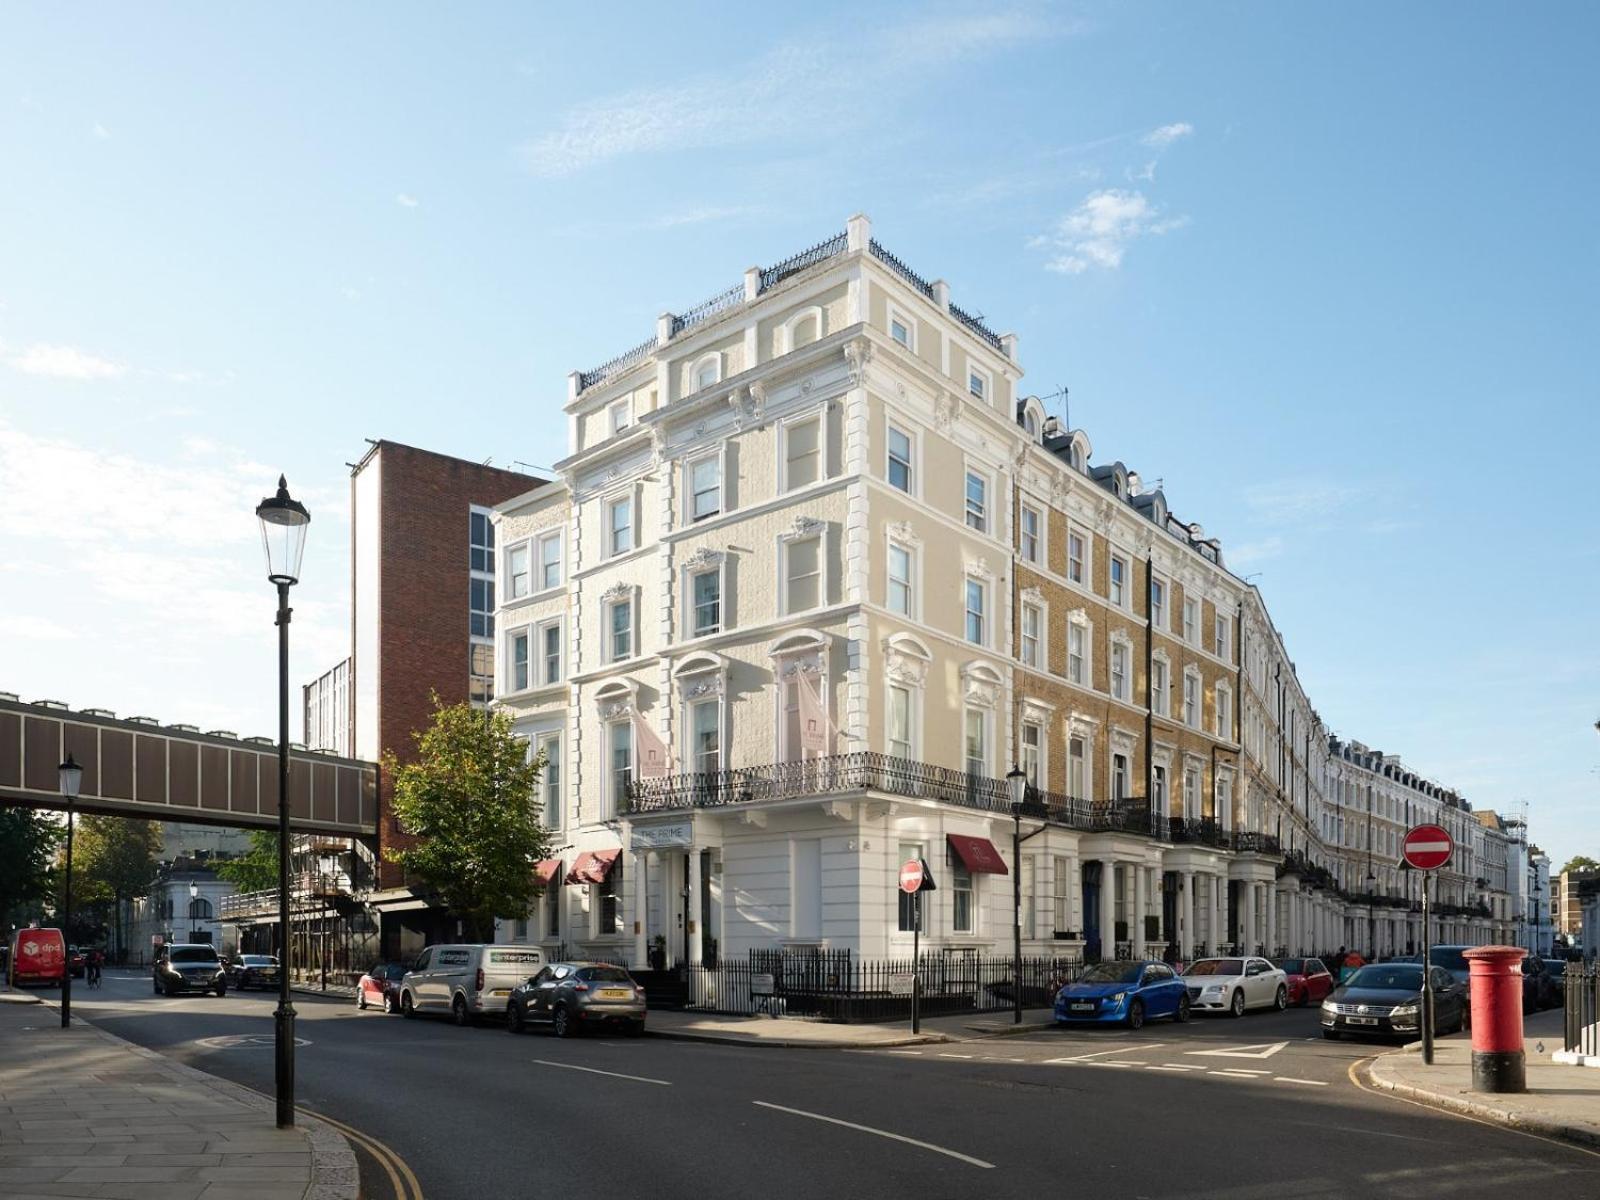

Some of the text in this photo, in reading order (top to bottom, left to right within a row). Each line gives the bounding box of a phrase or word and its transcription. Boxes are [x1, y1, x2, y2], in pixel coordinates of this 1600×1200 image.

[641, 827, 683, 839] THE PRIME
[42, 943, 60, 952] dpd
[495, 954, 539, 963] enterprise
